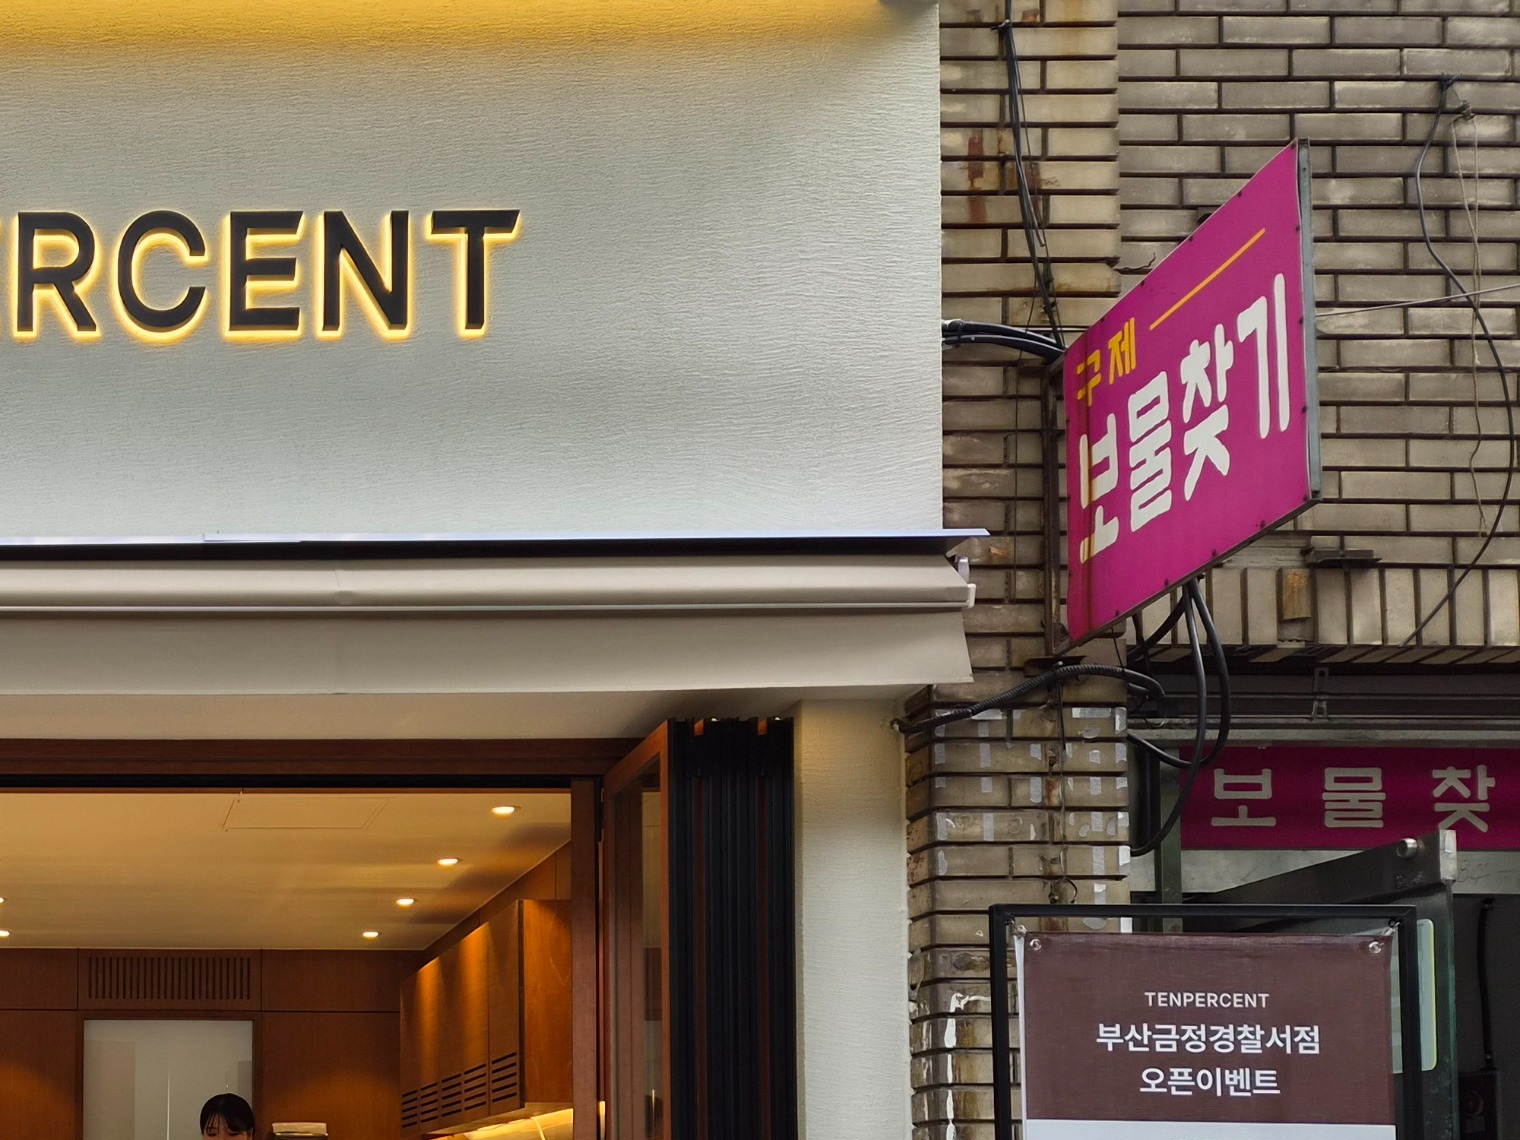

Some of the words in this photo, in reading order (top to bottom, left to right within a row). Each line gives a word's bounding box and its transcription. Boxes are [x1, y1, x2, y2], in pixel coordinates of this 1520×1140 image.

[1076, 317, 1137, 407] 구제
[1079, 273, 1291, 564] 보물찾기
[1144, 991, 1269, 1008] TENPERCENT
[1096, 1022, 1319, 1054] 부산금정경찰서점
[1139, 1066, 1280, 1097] 오픈이벤트
